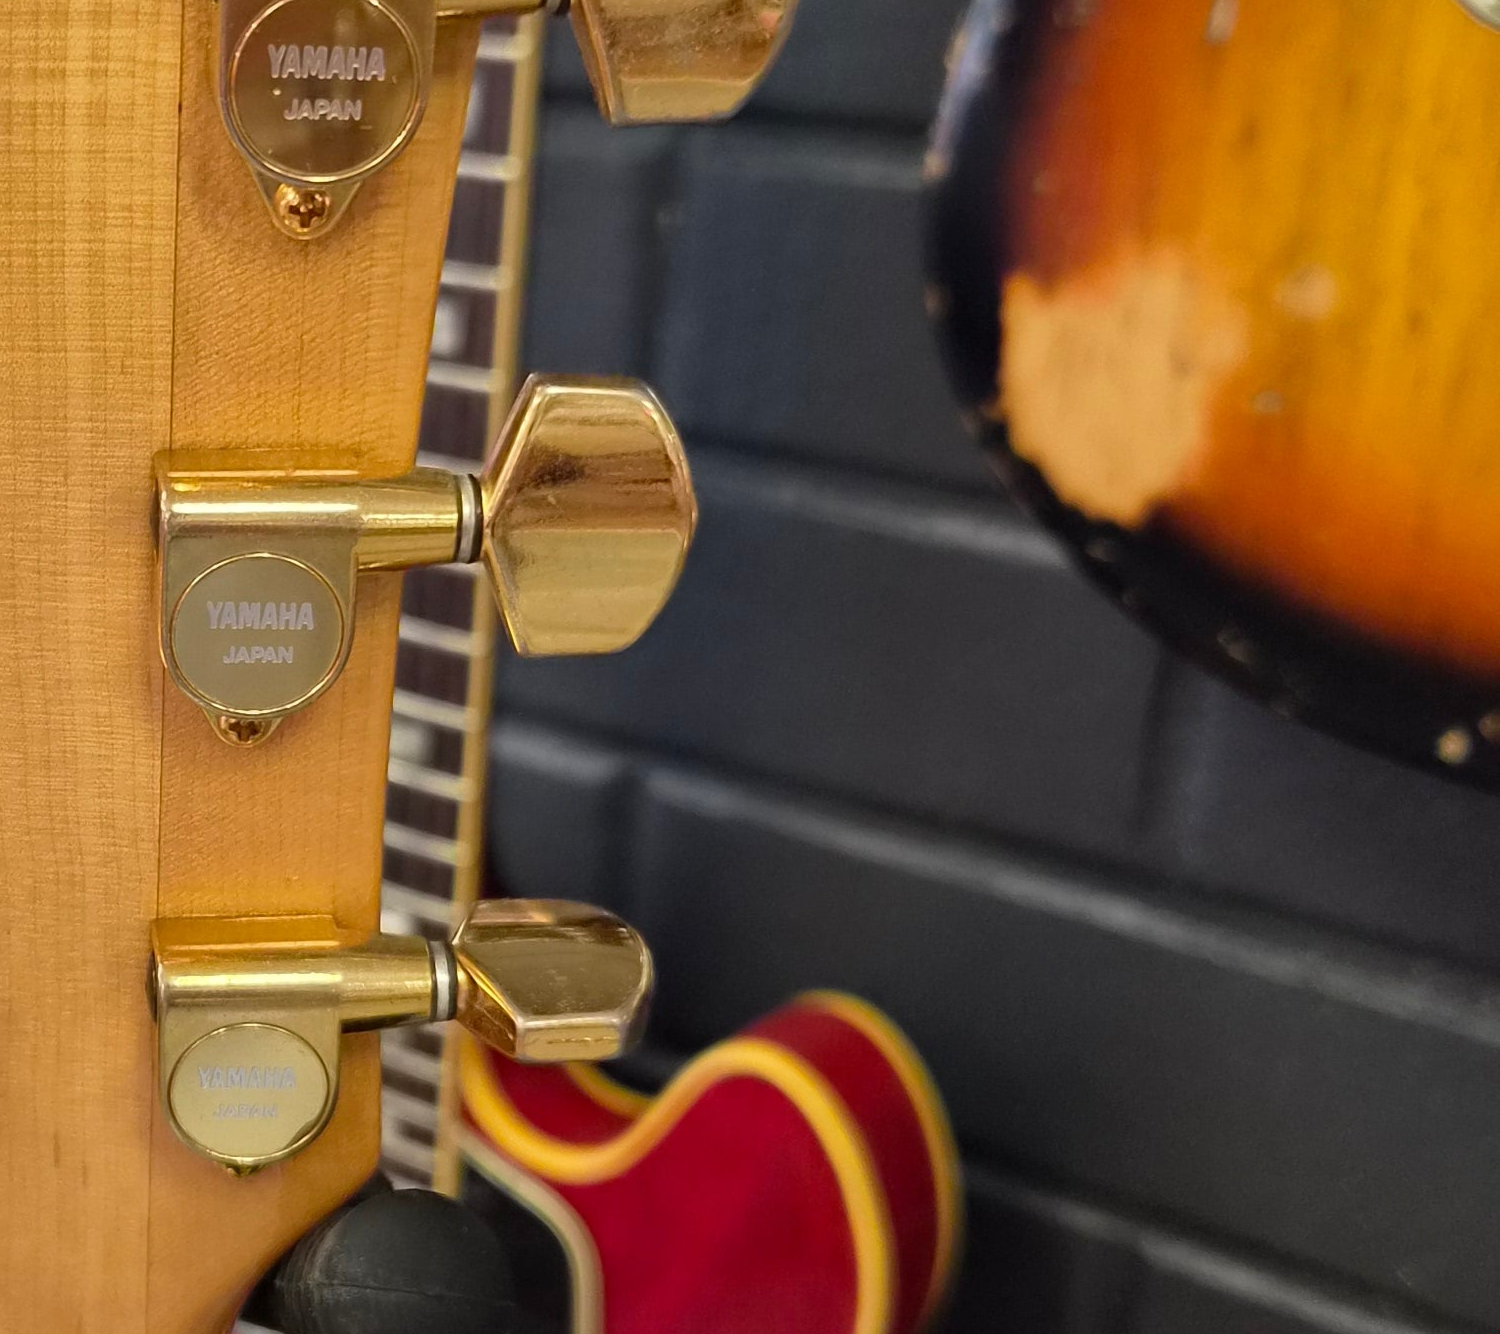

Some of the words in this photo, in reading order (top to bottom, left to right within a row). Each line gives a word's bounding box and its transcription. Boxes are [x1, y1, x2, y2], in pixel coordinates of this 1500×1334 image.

[269, 44, 384, 81] YAMAHA
[284, 97, 361, 121] JAPAN
[207, 602, 314, 630] YAMAHA
[223, 646, 293, 664] JAPAN
[198, 1065, 296, 1092] YAMAHA
[212, 1103, 278, 1119] JAPAN
